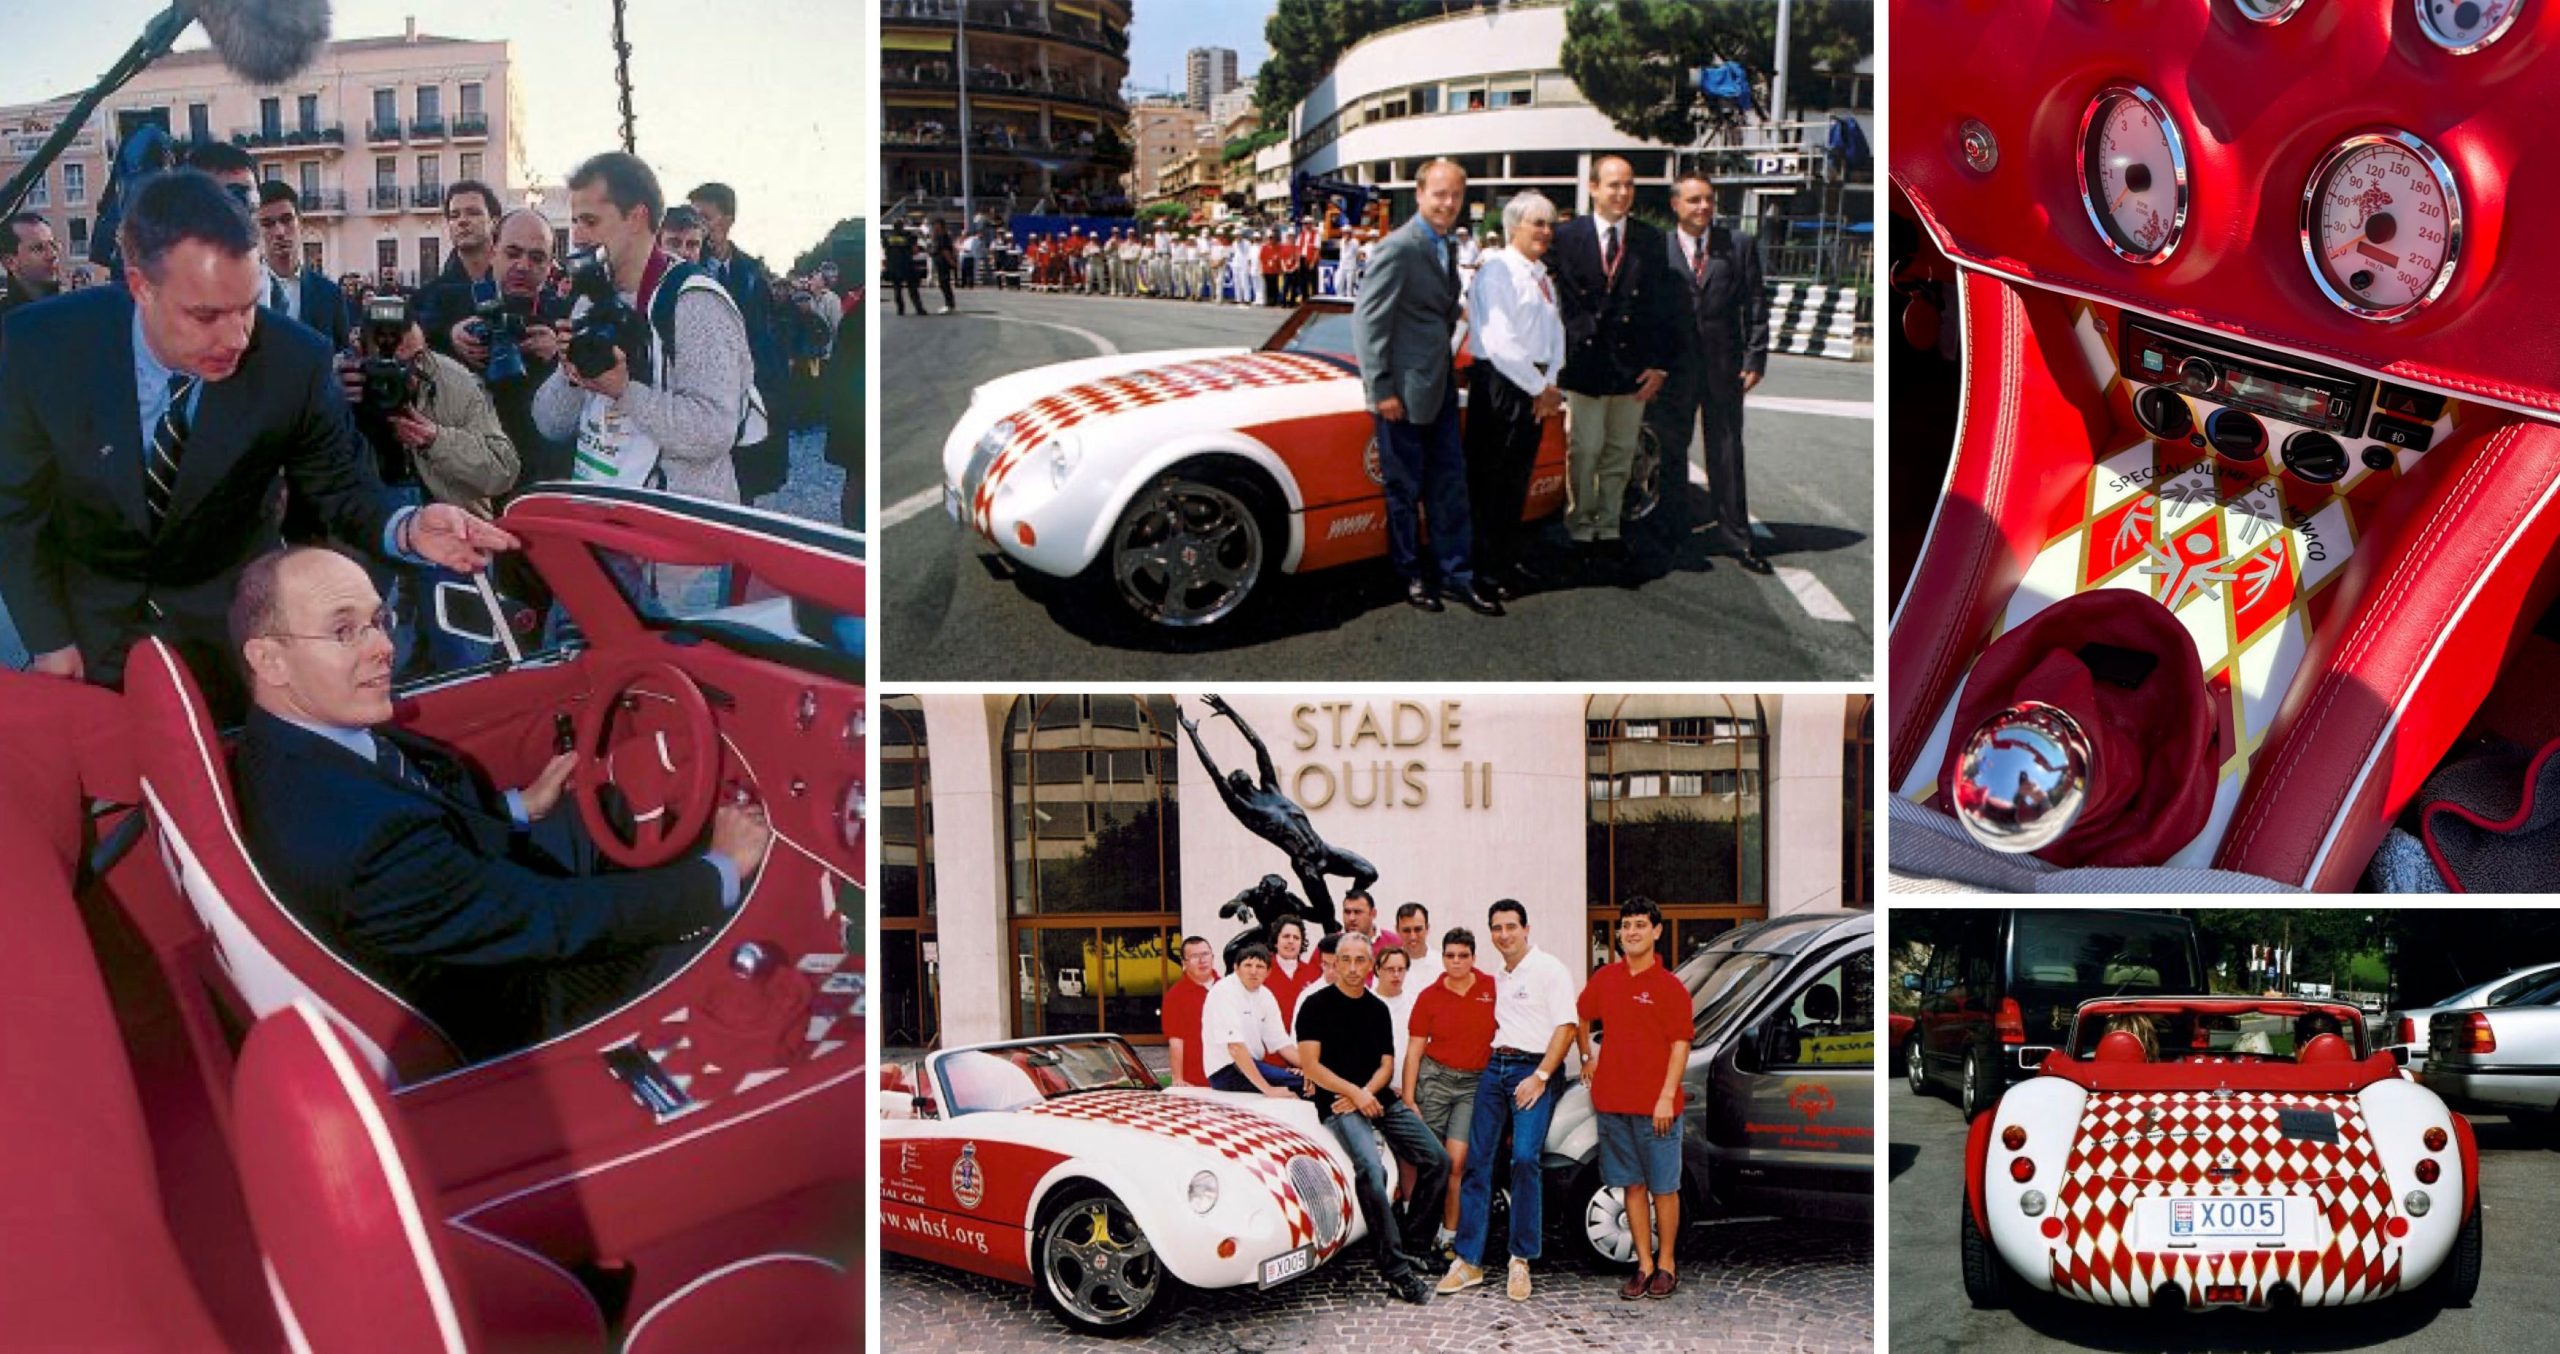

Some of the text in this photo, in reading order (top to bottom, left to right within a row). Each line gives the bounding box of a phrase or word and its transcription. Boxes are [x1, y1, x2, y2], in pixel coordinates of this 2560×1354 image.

[2121, 120, 2128, 132] 3
[2141, 115, 2149, 127] 4
[2110, 139, 2117, 151] 2
[2109, 169, 2114, 179] 1
[2366, 163, 2385, 179] 120
[2389, 161, 2410, 177] 150
[2349, 175, 2363, 189] 90
[2409, 179, 2431, 196] 180
[2337, 195, 2350, 208] 60
[2418, 201, 2440, 218] 210
[2333, 221, 2346, 233] 30
[2418, 226, 2441, 243] 240
[2364, 258, 2385, 272] km/h
[2409, 252, 2431, 270] 270
[2397, 270, 2418, 287] 300
[2109, 463, 2326, 562] SPECIAL OLYMPICS MONACO
[1291, 700, 1463, 750] STADE
[1463, 761, 1493, 809] II
[880, 1186, 926, 1204] IAL CAR
[2201, 1203, 2275, 1228] X005
[1276, 1252, 1305, 1277] X005
